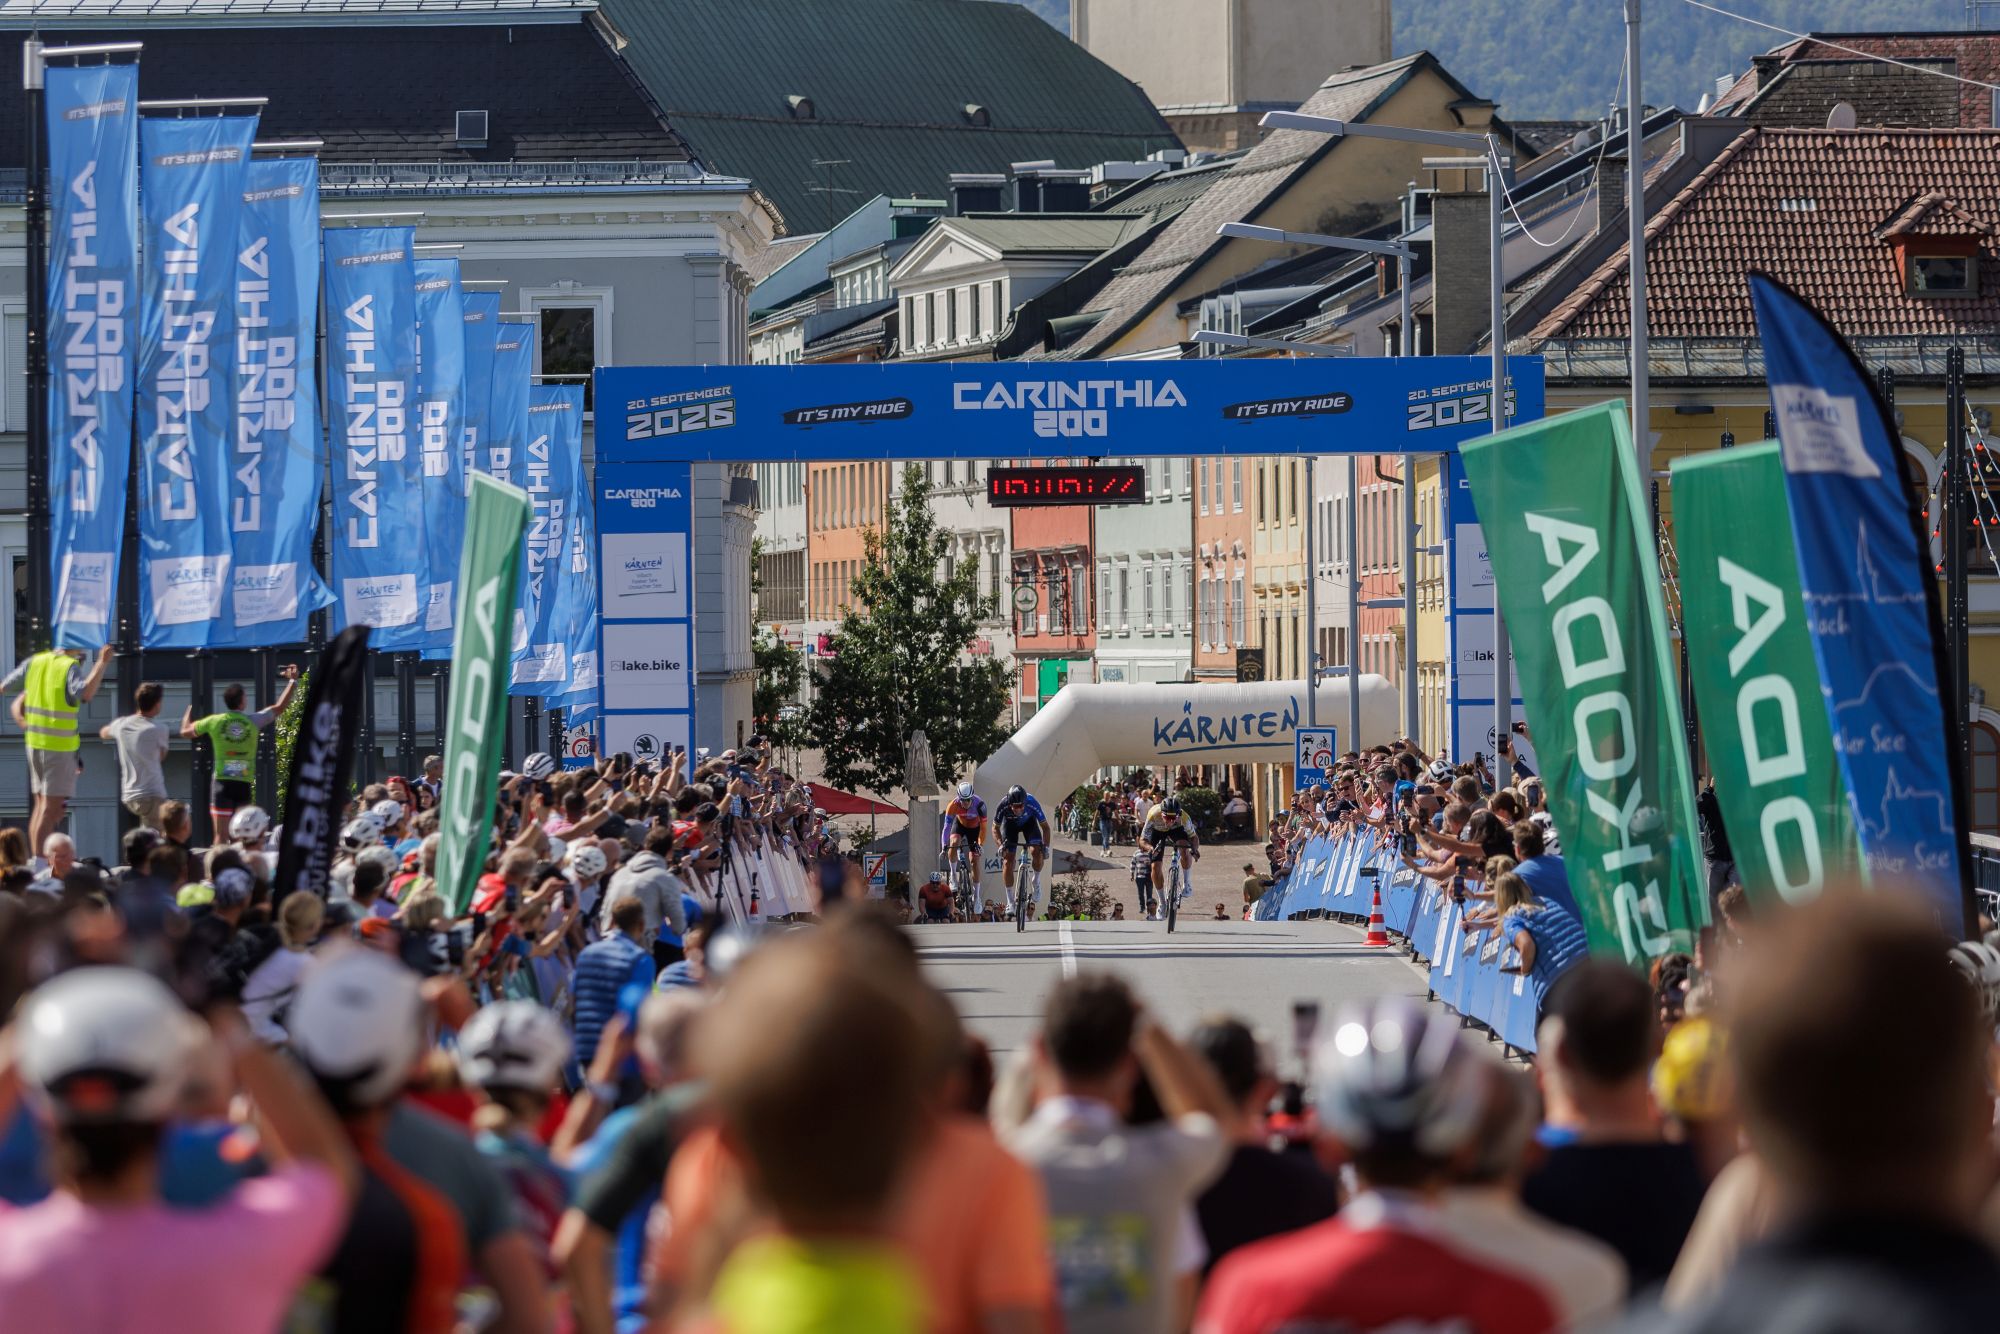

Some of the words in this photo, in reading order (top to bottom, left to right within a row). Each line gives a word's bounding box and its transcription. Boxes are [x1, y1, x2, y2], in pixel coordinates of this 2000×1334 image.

[161, 154, 185, 166] IT'S
[208, 149, 238, 162] RIDE
[271, 186, 300, 198] RIDE
[342, 255, 362, 266] IT'S
[362, 254, 379, 264] MY
[379, 251, 404, 262] RIDE
[424, 280, 449, 289] RIDE
[97, 280, 124, 392] 200
[157, 203, 200, 521] CARINTHIA
[187, 311, 217, 412] 200
[234, 237, 269, 533] CARINTHIA
[264, 336, 296, 431] 200
[953, 379, 1188, 410] CARINTHIA
[1407, 389, 1430, 401] 20.
[1431, 376, 1513, 397] SEPTEMBR
[627, 400, 649, 411] 20.
[650, 385, 732, 407] SEPTEMBER
[1236, 404, 1269, 418] IT'S
[1270, 400, 1303, 414] MY
[1303, 396, 1347, 411] RIDE
[344, 294, 378, 549] CARINTHIA
[377, 380, 407, 462] 200
[626, 399, 735, 442] 2026
[796, 408, 829, 423] IT'S
[830, 406, 863, 420] MY
[864, 401, 907, 417] RIDE
[1033, 409, 1108, 438] 200
[422, 401, 450, 477] 200
[604, 487, 682, 500] CARINTHIA
[630, 498, 656, 508] 200
[621, 659, 681, 671] lake.bike
[1153, 695, 1300, 747] KÄRNTEN
[577, 744, 589, 755] 20
[1318, 755, 1330, 767] 20
[1303, 774, 1329, 785] Zone
